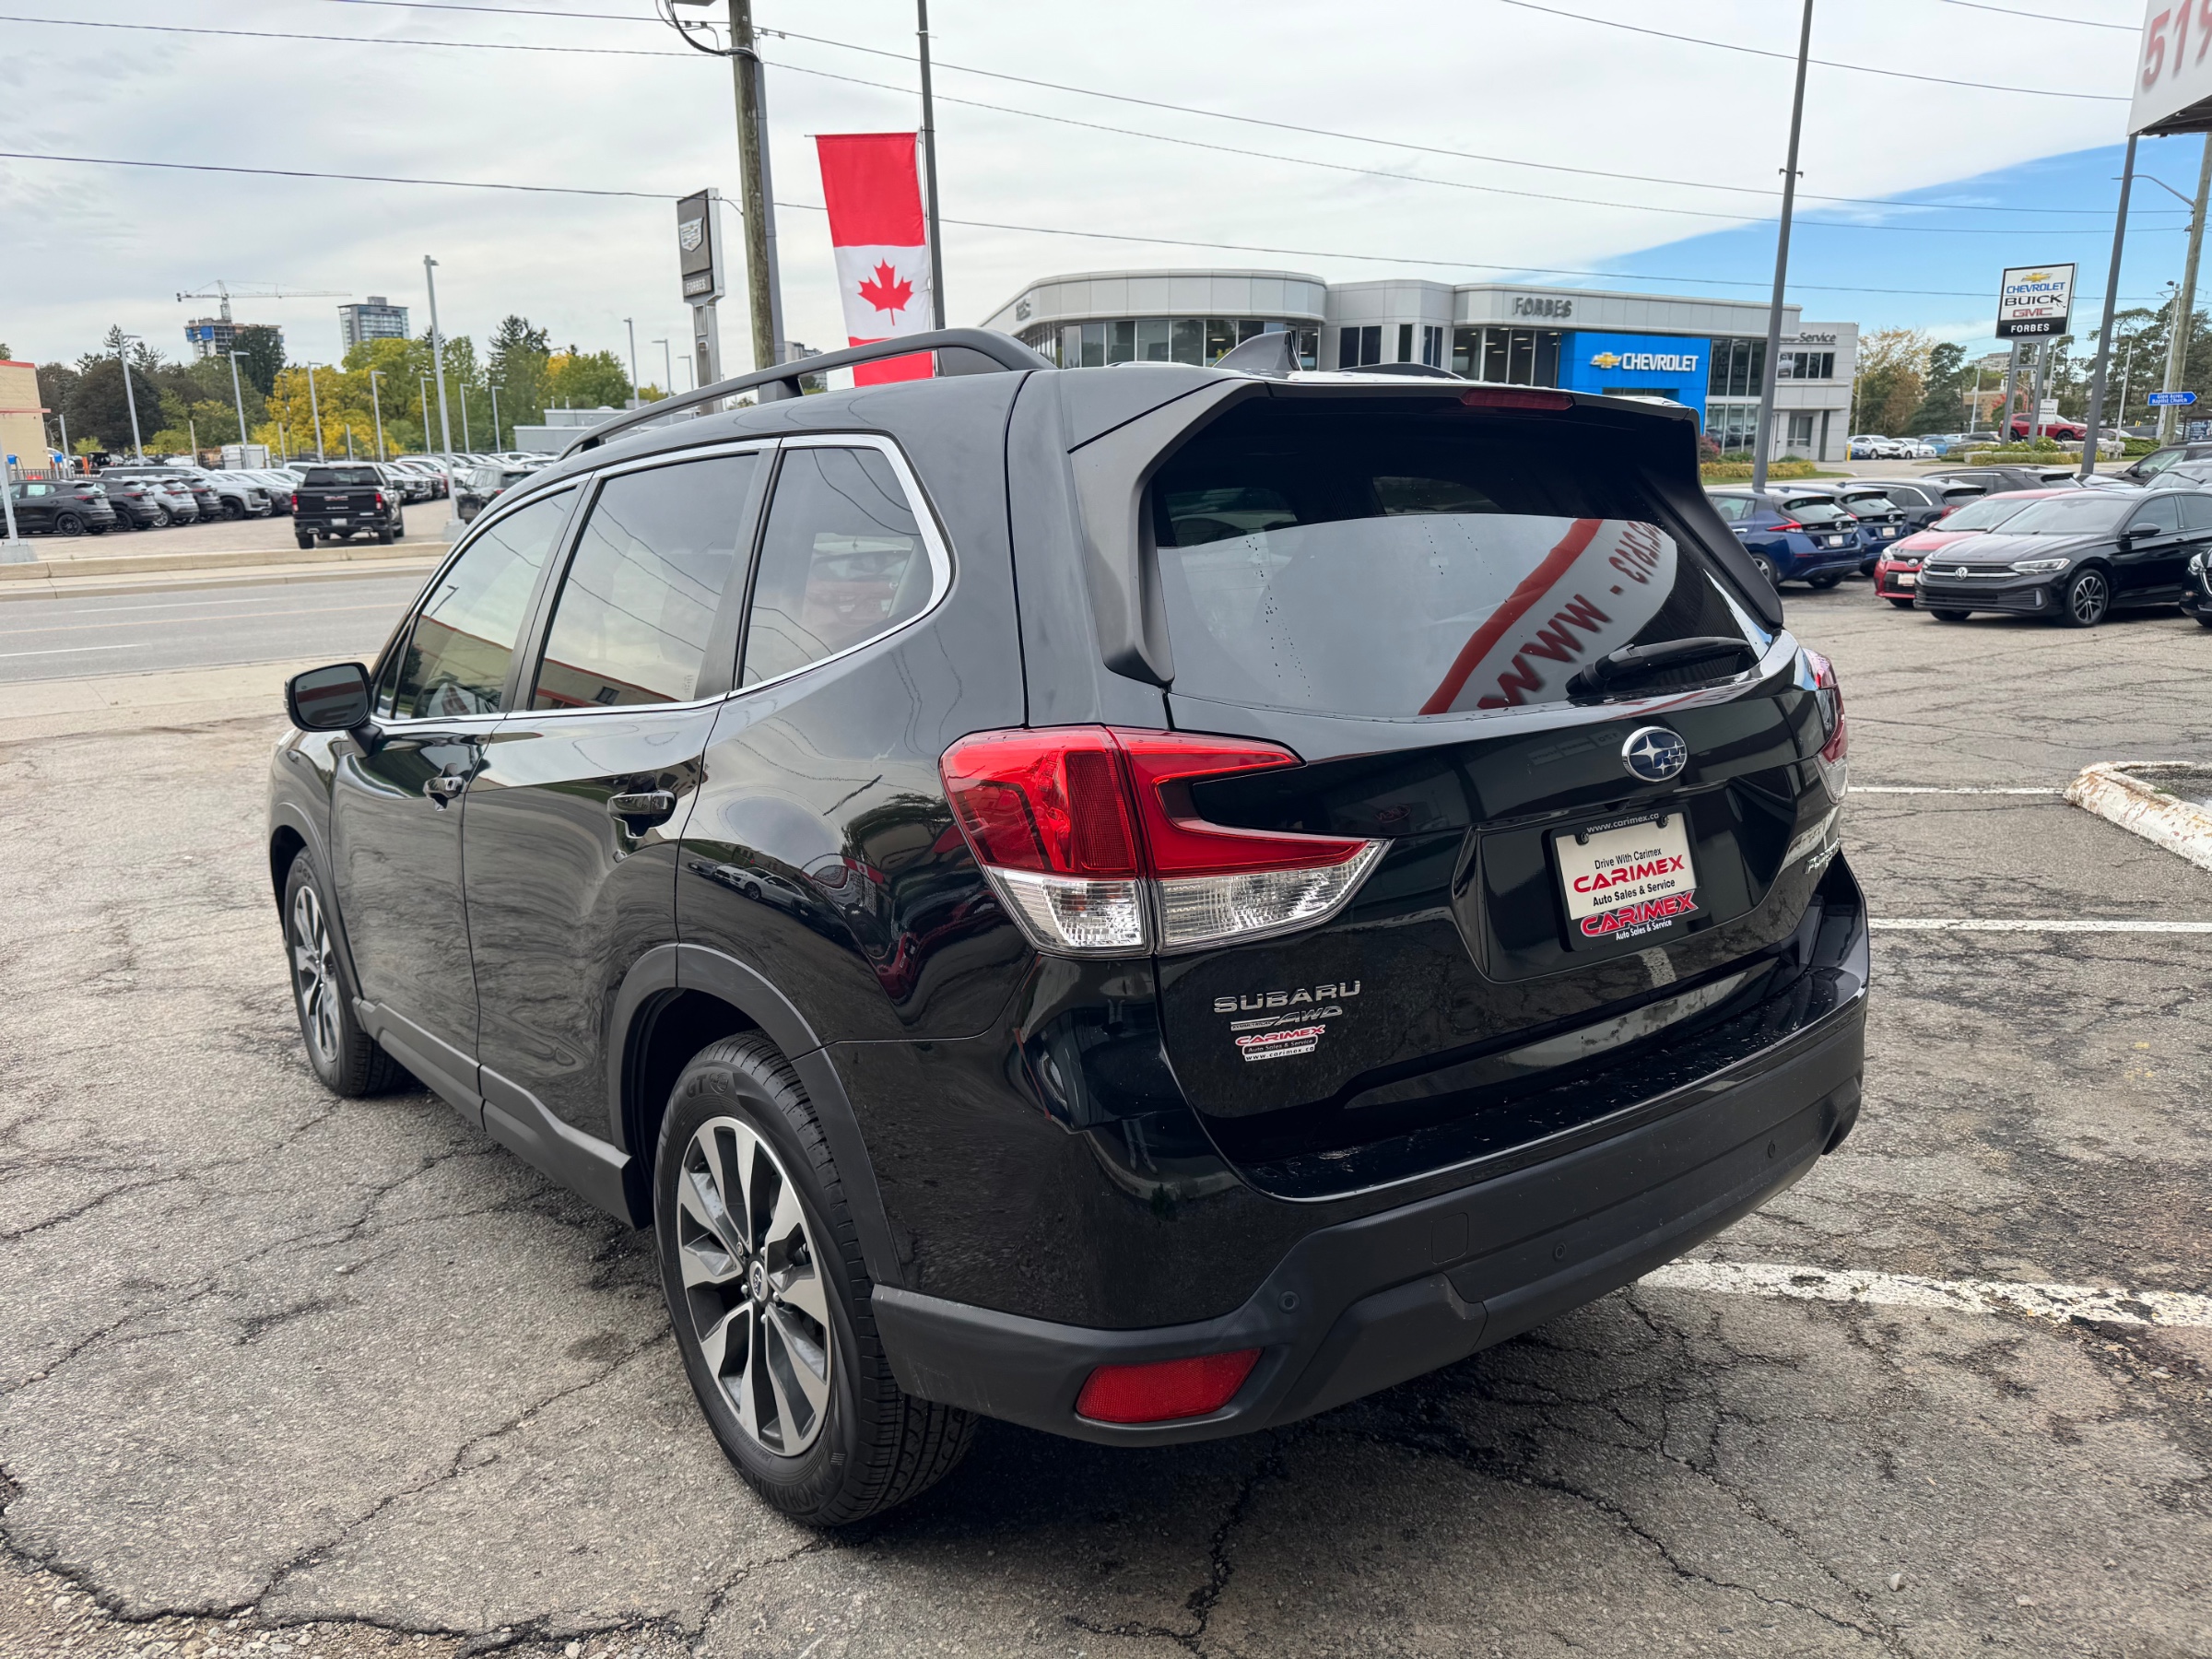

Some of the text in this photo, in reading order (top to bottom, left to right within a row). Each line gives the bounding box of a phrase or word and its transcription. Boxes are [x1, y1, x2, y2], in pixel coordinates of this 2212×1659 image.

[2006, 282, 2065, 294] CHEVROLET
[1513, 298, 1571, 317] FORBES
[2005, 294, 2064, 306] BUICK
[2013, 308, 2053, 318] GMC
[1799, 332, 1836, 342] Service
[2011, 324, 2050, 333] FORBES
[1622, 353, 1699, 371] CHEVROLET
[1586, 812, 1659, 833] www.carimex.ca
[1594, 847, 1662, 870] Drive With Carimex
[1573, 854, 1685, 893] CARIMEX
[1593, 878, 1676, 907] Auto Sales & Service
[1581, 890, 1699, 936] CARIMEX
[1616, 918, 1673, 941] Auto Sales & Service
[1213, 980, 1361, 1013] SUBARU
[1274, 1006, 1343, 1026] AWD
[1236, 1026, 1324, 1045] CARIMEX
[1245, 1046, 1314, 1061] www.carimex.ca
[1265, 1042, 1283, 1052] Sales
[1290, 1039, 1313, 1047] Service
[686, 1074, 707, 1098] GT
